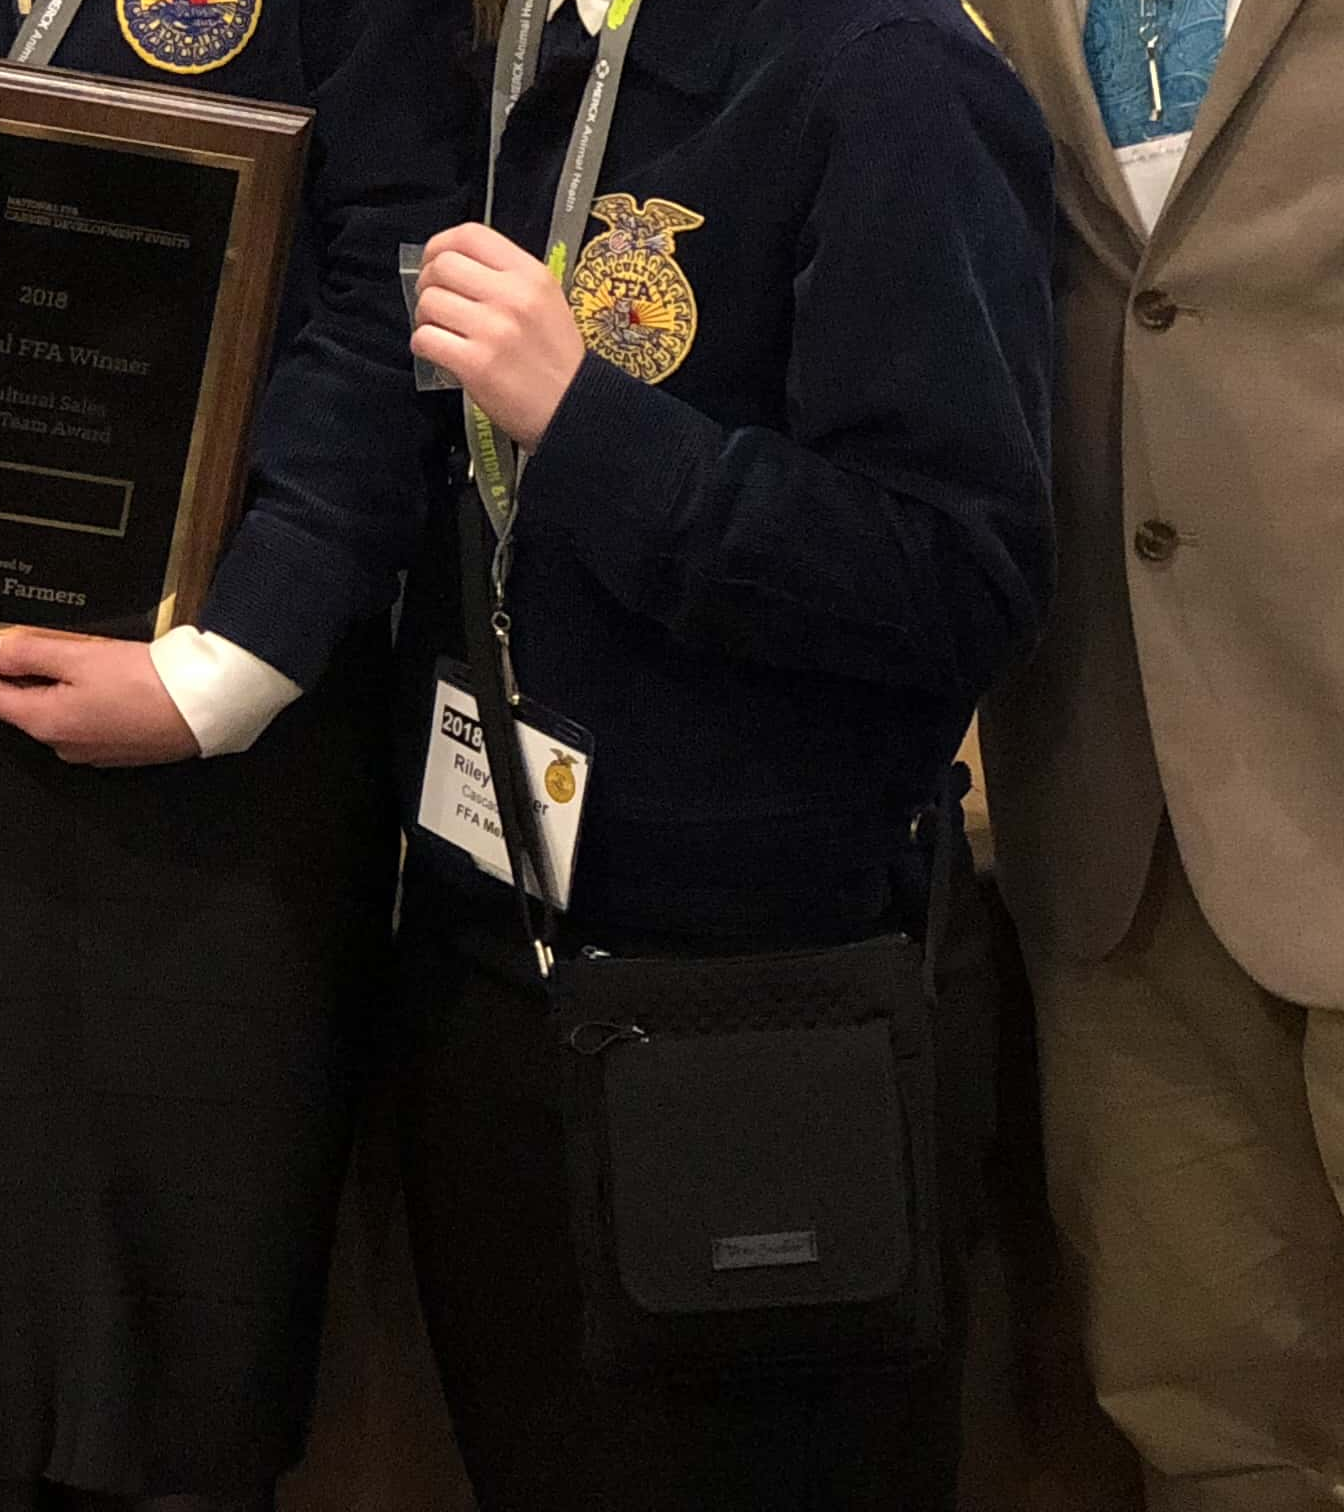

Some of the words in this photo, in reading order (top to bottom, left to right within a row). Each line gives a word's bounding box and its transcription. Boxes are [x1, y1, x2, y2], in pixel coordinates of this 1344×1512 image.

[17, 29, 43, 63] Anim
[514, 18, 531, 61] Animal
[586, 80, 605, 123] MERCK
[575, 124, 593, 171] Animal
[564, 172, 583, 213] Health
[19, 286, 69, 309] 2018
[608, 277, 653, 302] FFA
[17, 337, 65, 363] FFA
[69, 345, 152, 376] Winner
[59, 394, 107, 418] Sales
[50, 419, 112, 444] Award
[18, 560, 33, 575] by
[1, 576, 88, 607] Farmers
[442, 711, 484, 748] 2018
[453, 753, 491, 788] Riley
[455, 803, 480, 826] FFA
